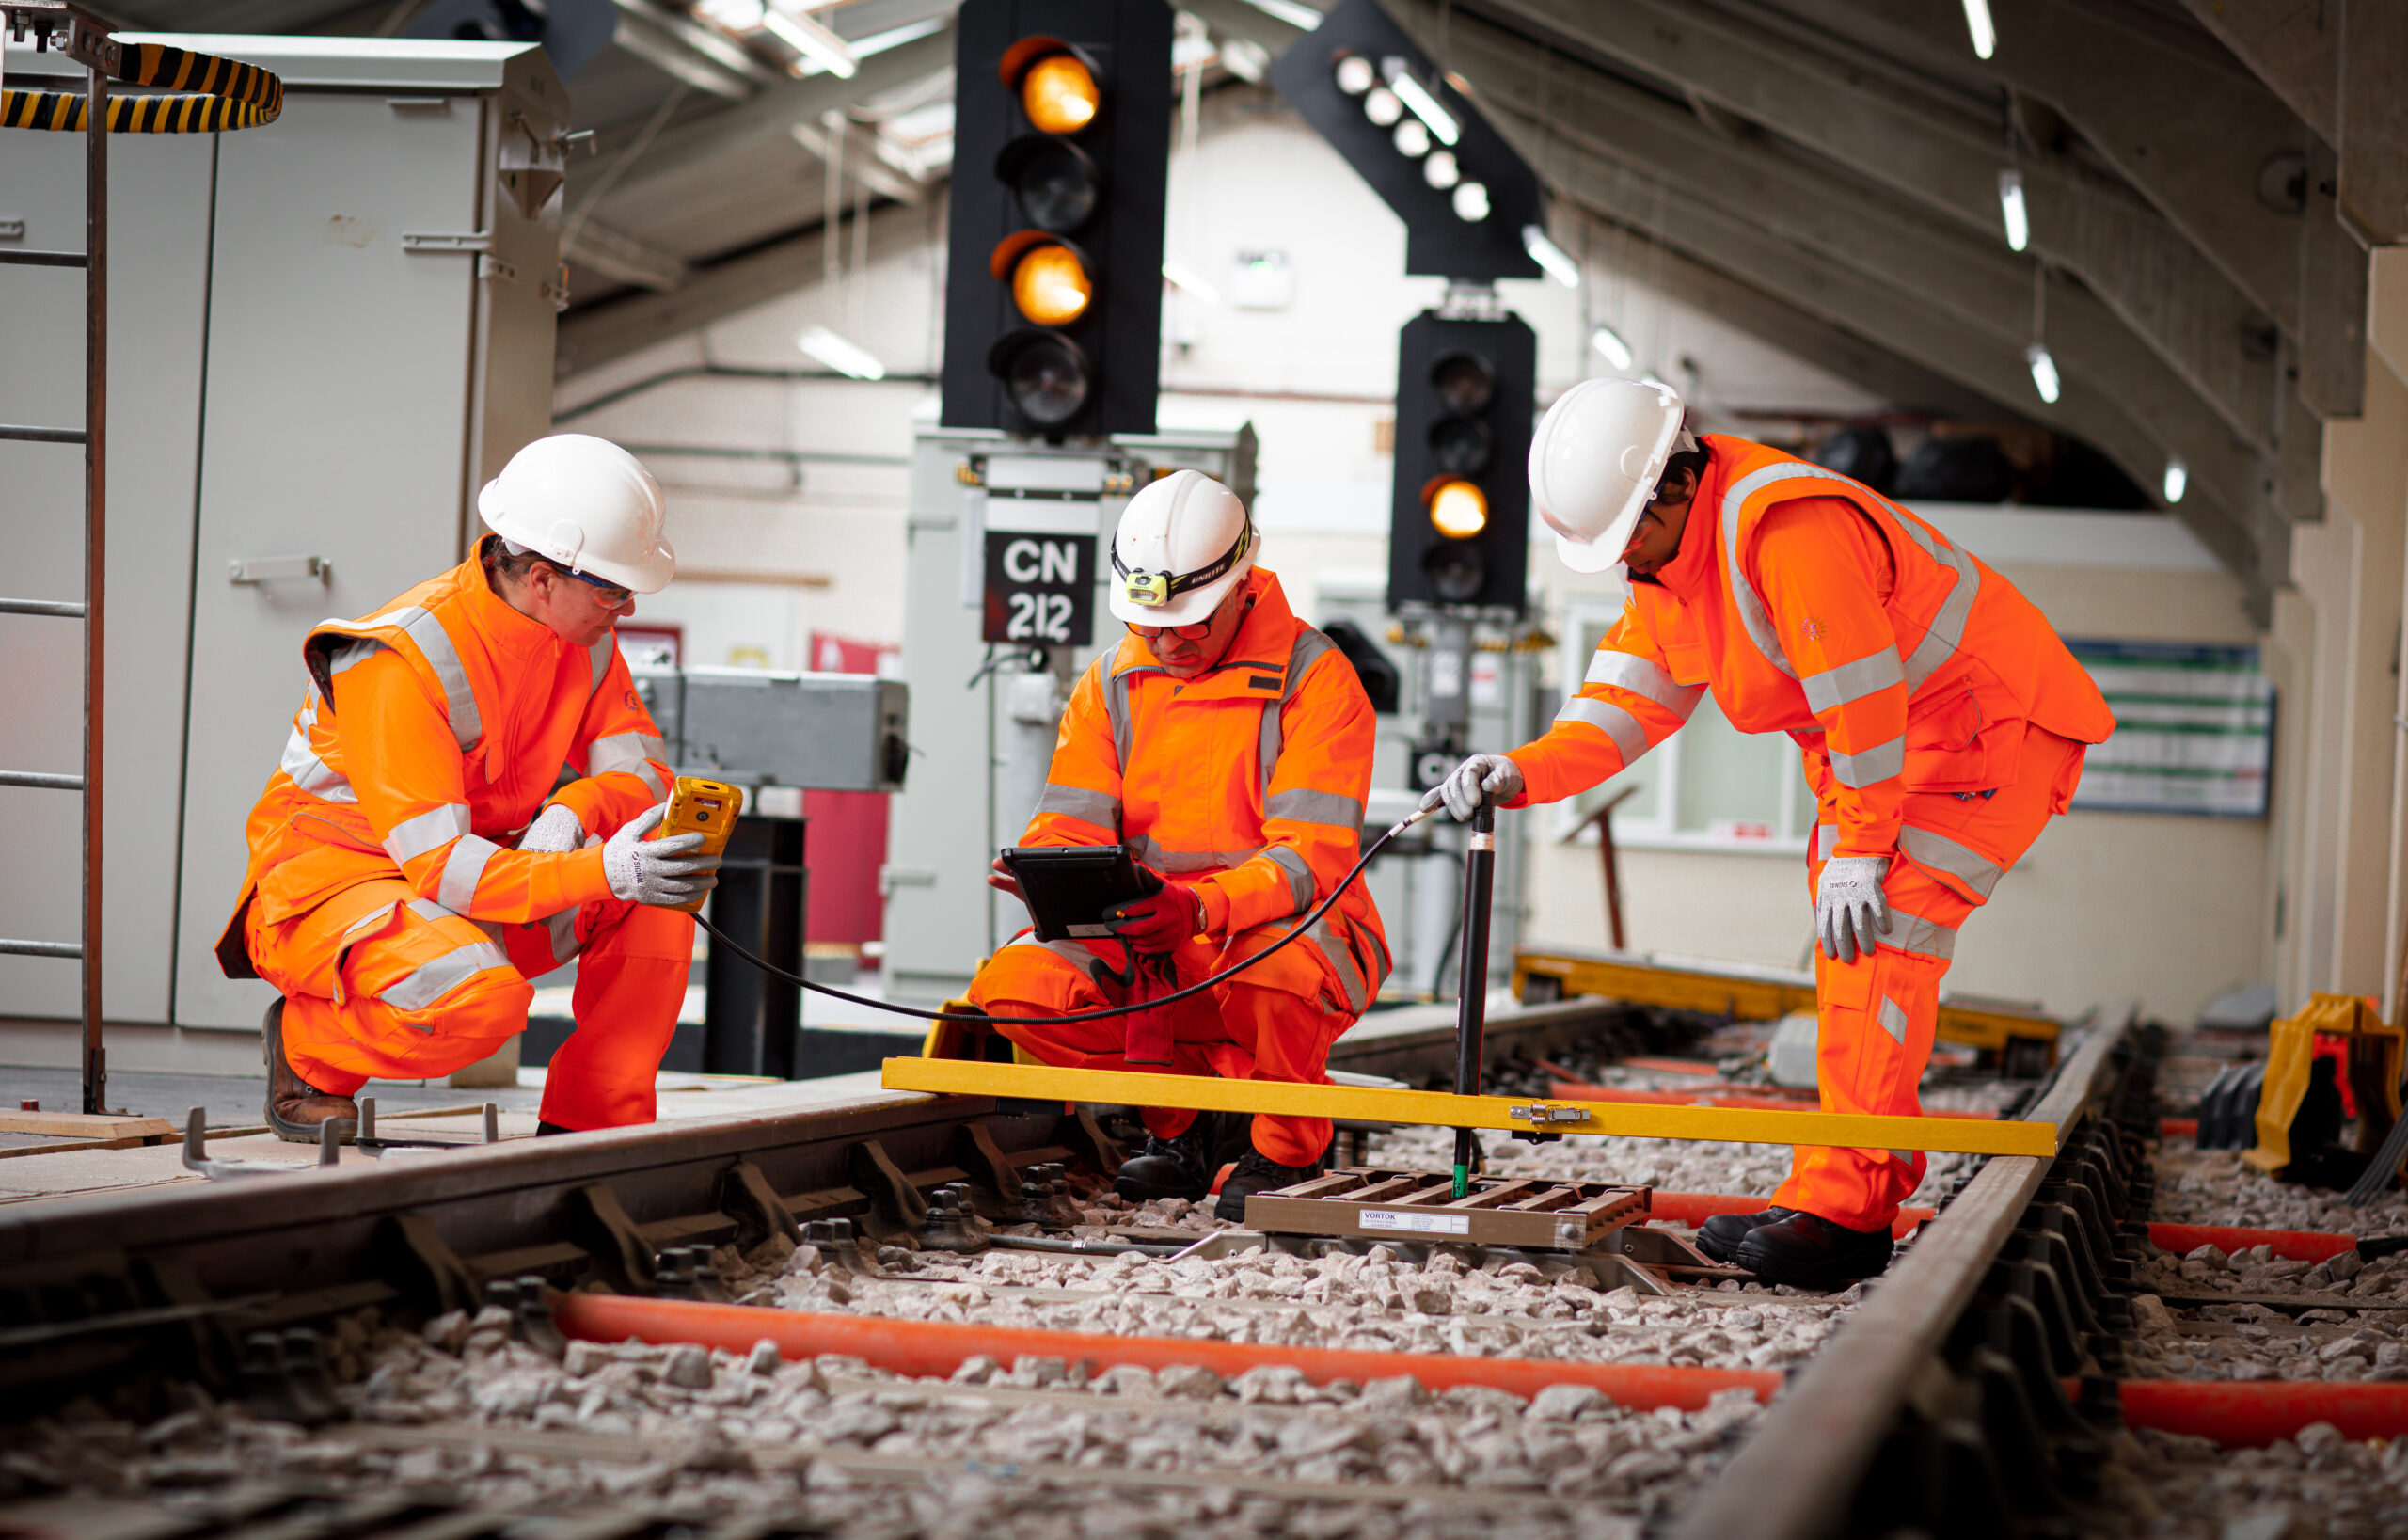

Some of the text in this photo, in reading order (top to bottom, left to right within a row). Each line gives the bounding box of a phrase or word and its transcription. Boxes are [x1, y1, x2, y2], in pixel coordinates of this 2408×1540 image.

[1004, 539, 1077, 583] CN
[1191, 564, 1226, 584] UNILITE
[1007, 592, 1072, 642] 212
[633, 861, 643, 884] SIGNAL
